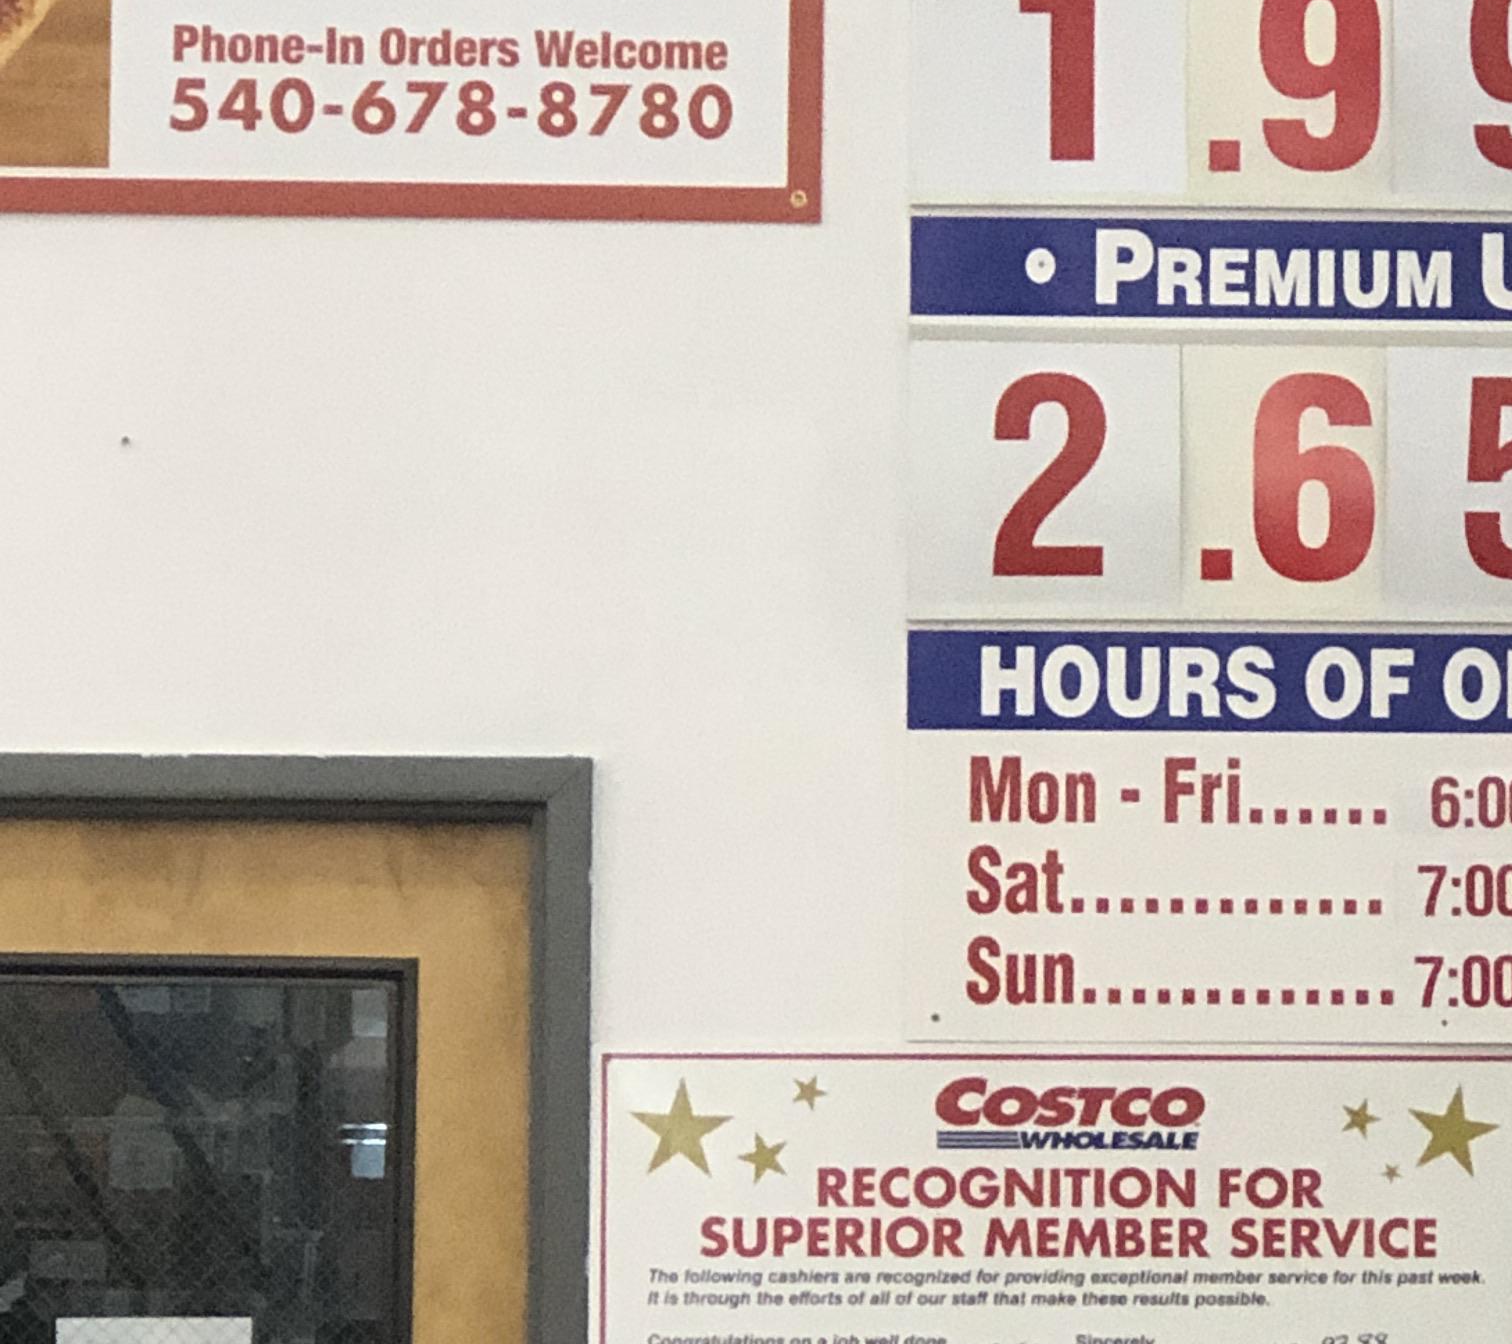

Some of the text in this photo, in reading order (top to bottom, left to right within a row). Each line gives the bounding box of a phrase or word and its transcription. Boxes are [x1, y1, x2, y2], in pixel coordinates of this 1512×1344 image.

[172, 23, 730, 71] Phone-In Orders Welcome
[168, 76, 734, 141] 540-678-8780
[1094, 228, 1453, 310] PREMIUM
[978, 644, 1277, 721] HOURS
[1305, 646, 1416, 721] OF
[968, 755, 1097, 824] Mon
[936, 1077, 1206, 1127] COSTCO
[1020, 1130, 1199, 1151] WHOLESALE
[816, 1166, 1324, 1209] RECOGNITION FOR
[700, 1216, 1438, 1259] SUPERIOR MEMBER SERVICE
[647, 1290, 1271, 1309] It is through the efforts of all of our staff that make these results possible.
[648, 1268, 1486, 1288] The following cashiers are recognized for providing exceptional member service for this past week.
